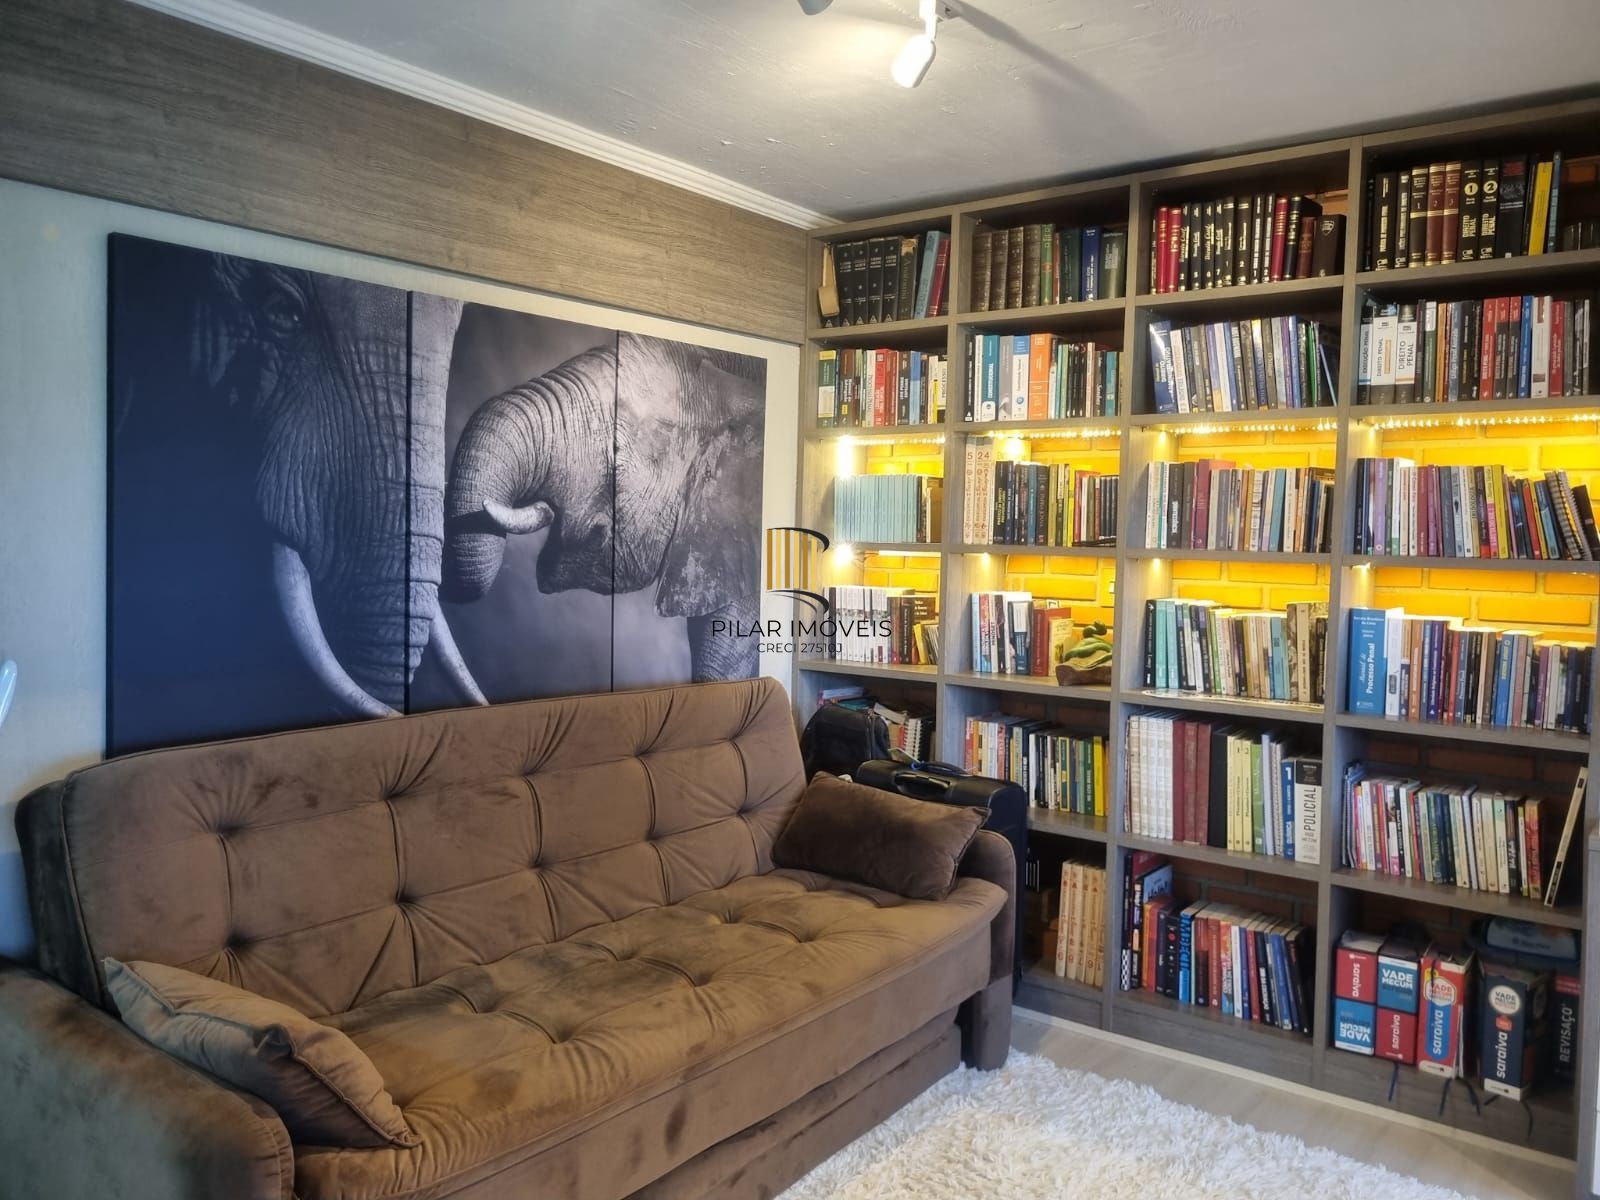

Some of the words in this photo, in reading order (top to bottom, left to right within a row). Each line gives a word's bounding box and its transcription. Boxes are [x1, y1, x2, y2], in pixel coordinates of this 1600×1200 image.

[1486, 182, 1494, 192] 2
[1468, 218, 1476, 237] PENAL
[1285, 766, 1292, 780] 1
[1303, 787, 1316, 831] POLICIAL
[1352, 962, 1360, 998] saraiva
[1382, 968, 1413, 983] VADE
[1382, 977, 1413, 990] MECUM
[1430, 983, 1452, 993] ADE
[1494, 991, 1516, 1002] VADE
[1339, 1021, 1371, 1034] MECUM
[1391, 1014, 1402, 1050] saraiva
[1432, 1010, 1444, 1054] saraiva
[1559, 1006, 1573, 1064] REVISAÇO
[1339, 1028, 1371, 1043] VADE
[1496, 1032, 1508, 1078] saraiva
